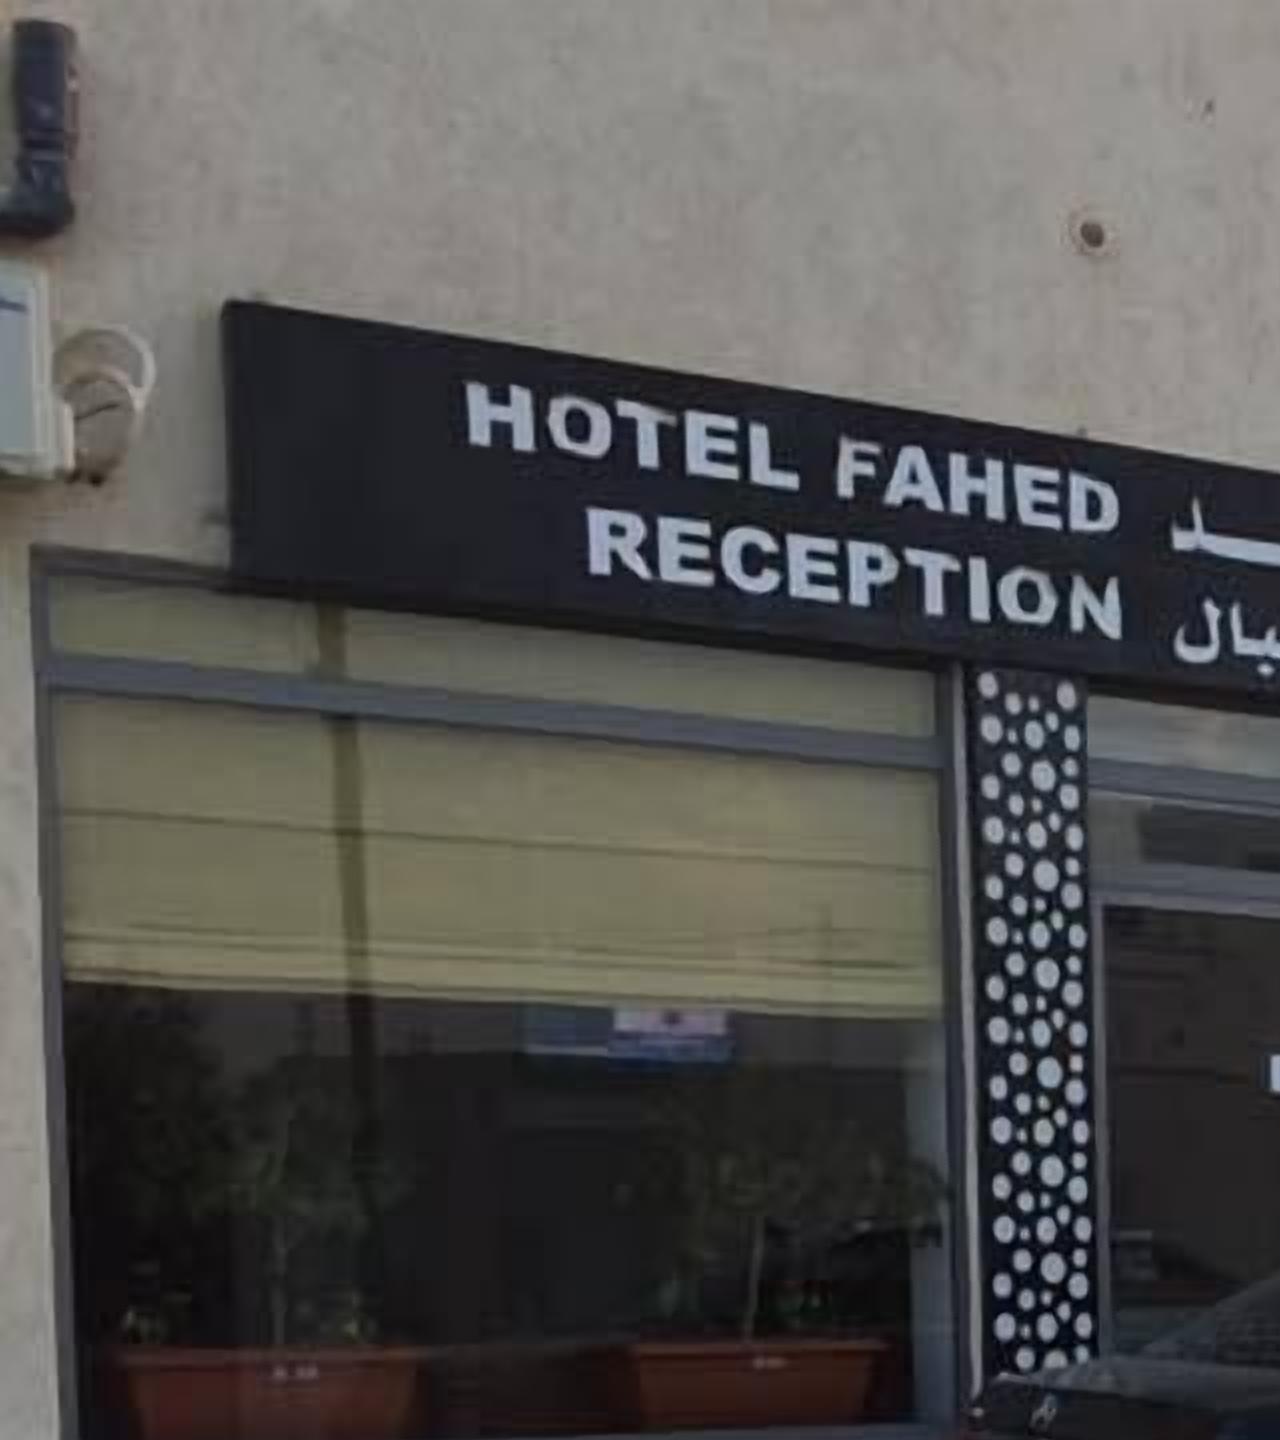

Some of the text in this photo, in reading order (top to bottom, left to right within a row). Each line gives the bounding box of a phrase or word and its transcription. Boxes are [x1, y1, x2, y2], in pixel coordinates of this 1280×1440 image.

[465, 381, 1121, 533] HOTEL FAHED
[586, 507, 1122, 640] RECEPTION
